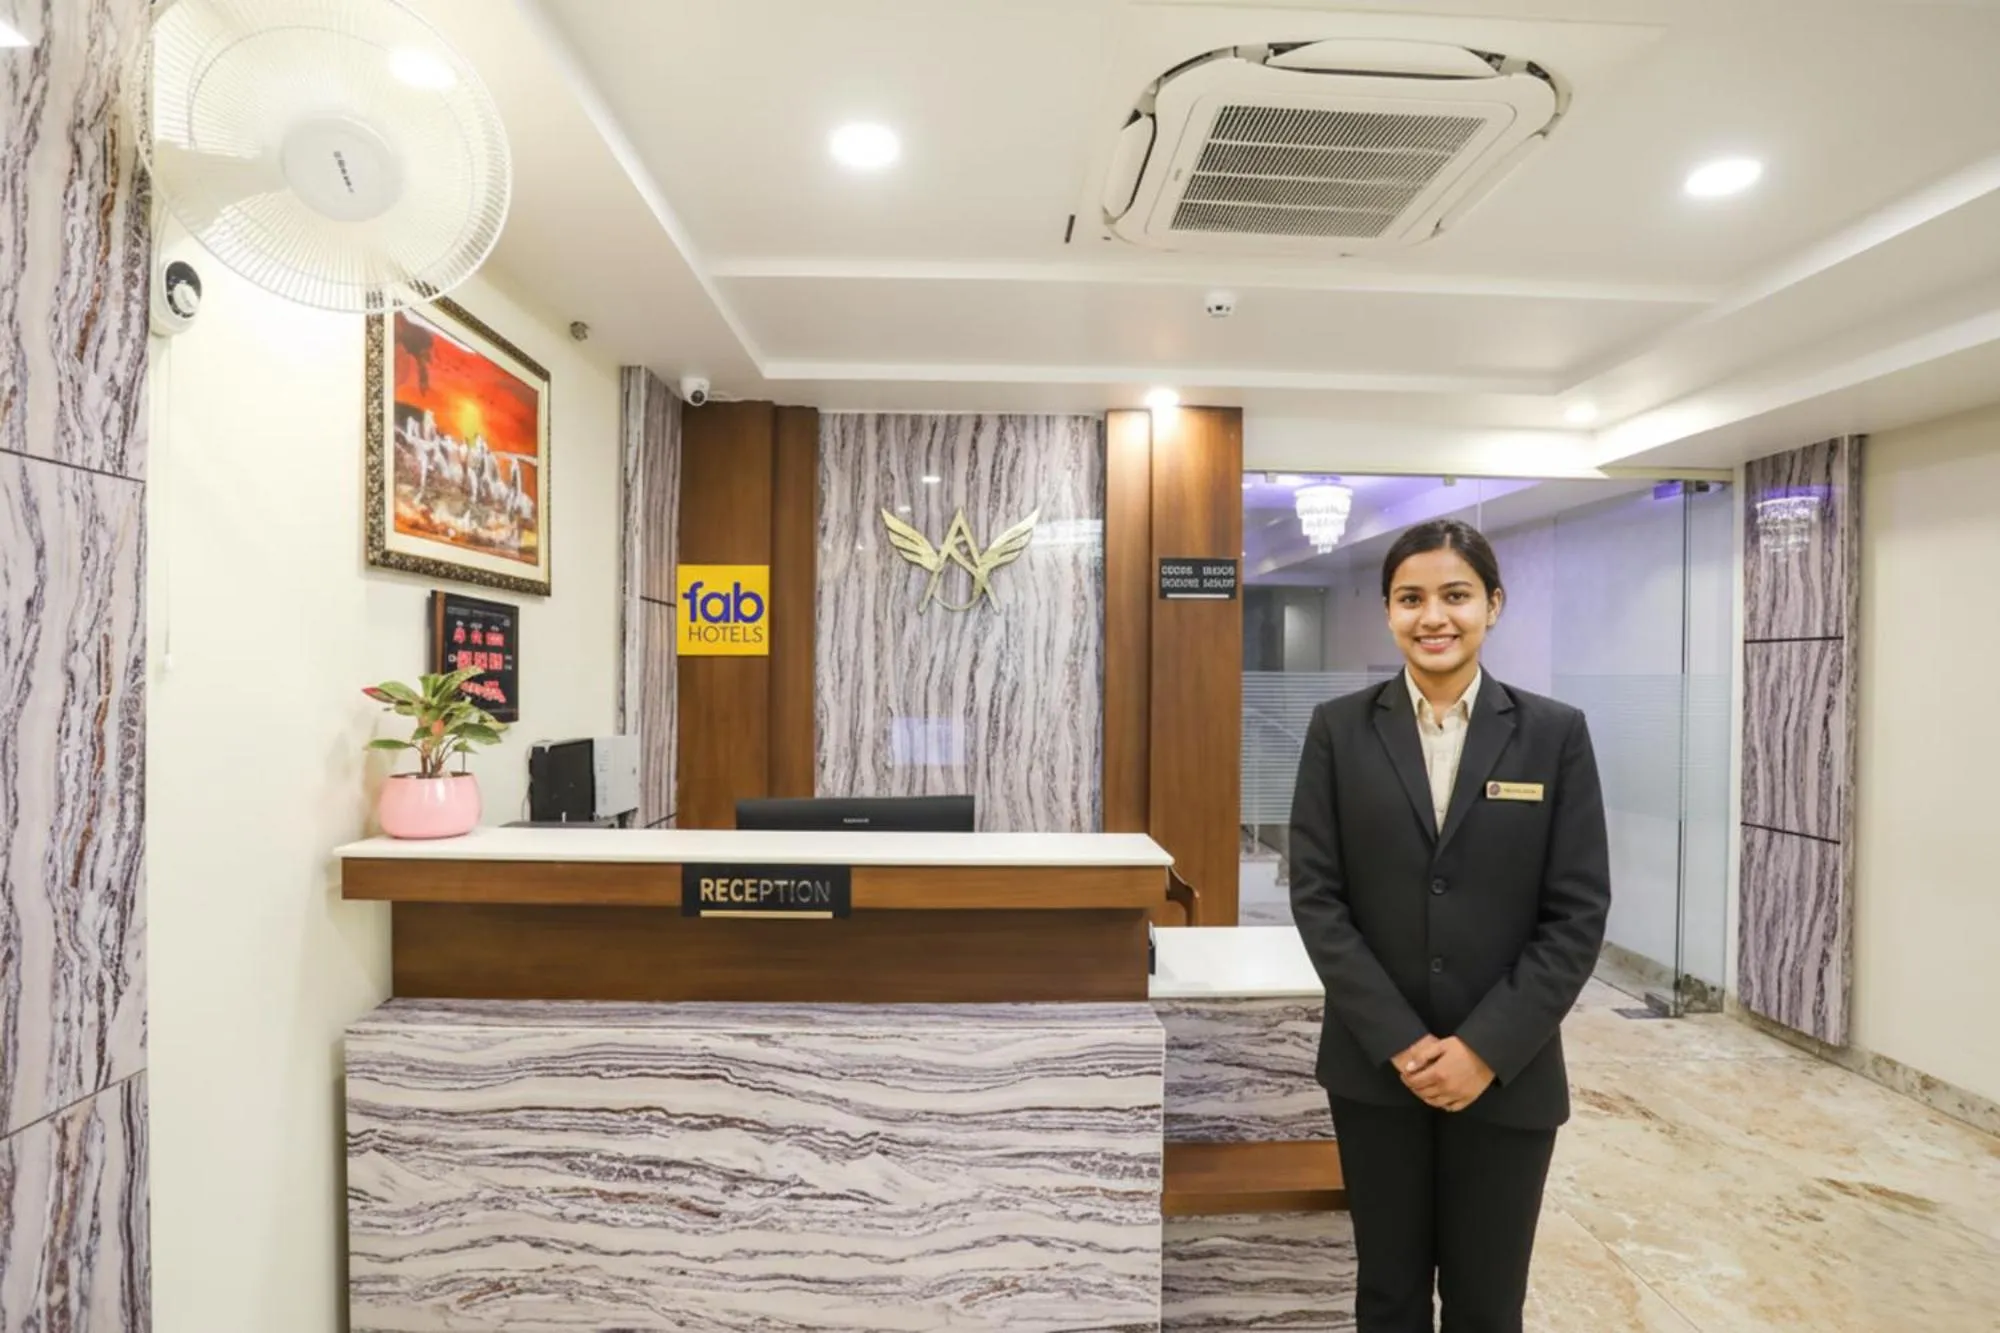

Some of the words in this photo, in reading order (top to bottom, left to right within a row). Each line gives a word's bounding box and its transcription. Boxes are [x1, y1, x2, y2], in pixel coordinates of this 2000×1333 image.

[682, 581, 765, 623] fab
[688, 625, 763, 643] HOTELS
[700, 877, 832, 904] RECEPTION
